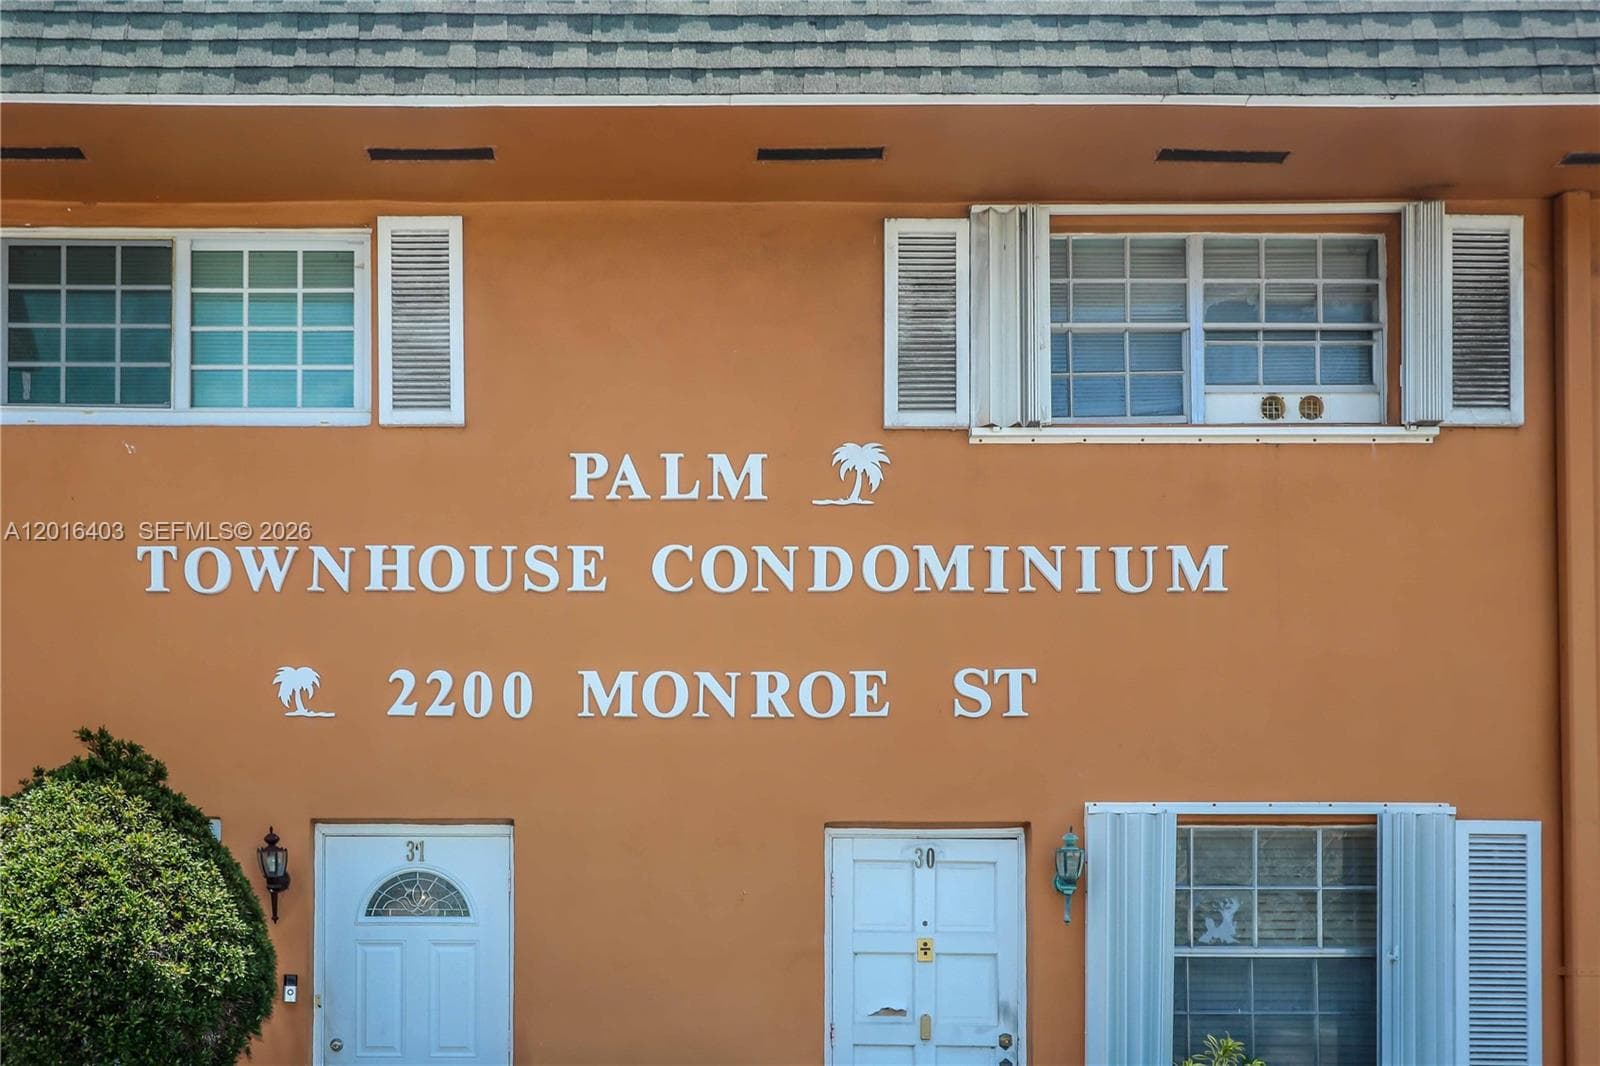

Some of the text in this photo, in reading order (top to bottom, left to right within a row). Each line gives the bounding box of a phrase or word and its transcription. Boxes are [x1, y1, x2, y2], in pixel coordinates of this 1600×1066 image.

[569, 452, 769, 502] PALM
[136, 544, 1230, 594] TOWNHOUSE CONDOMINIUM
[386, 667, 1037, 719] 2200 MONROE ST
[406, 840, 425, 862] 31
[914, 847, 935, 869] 30
